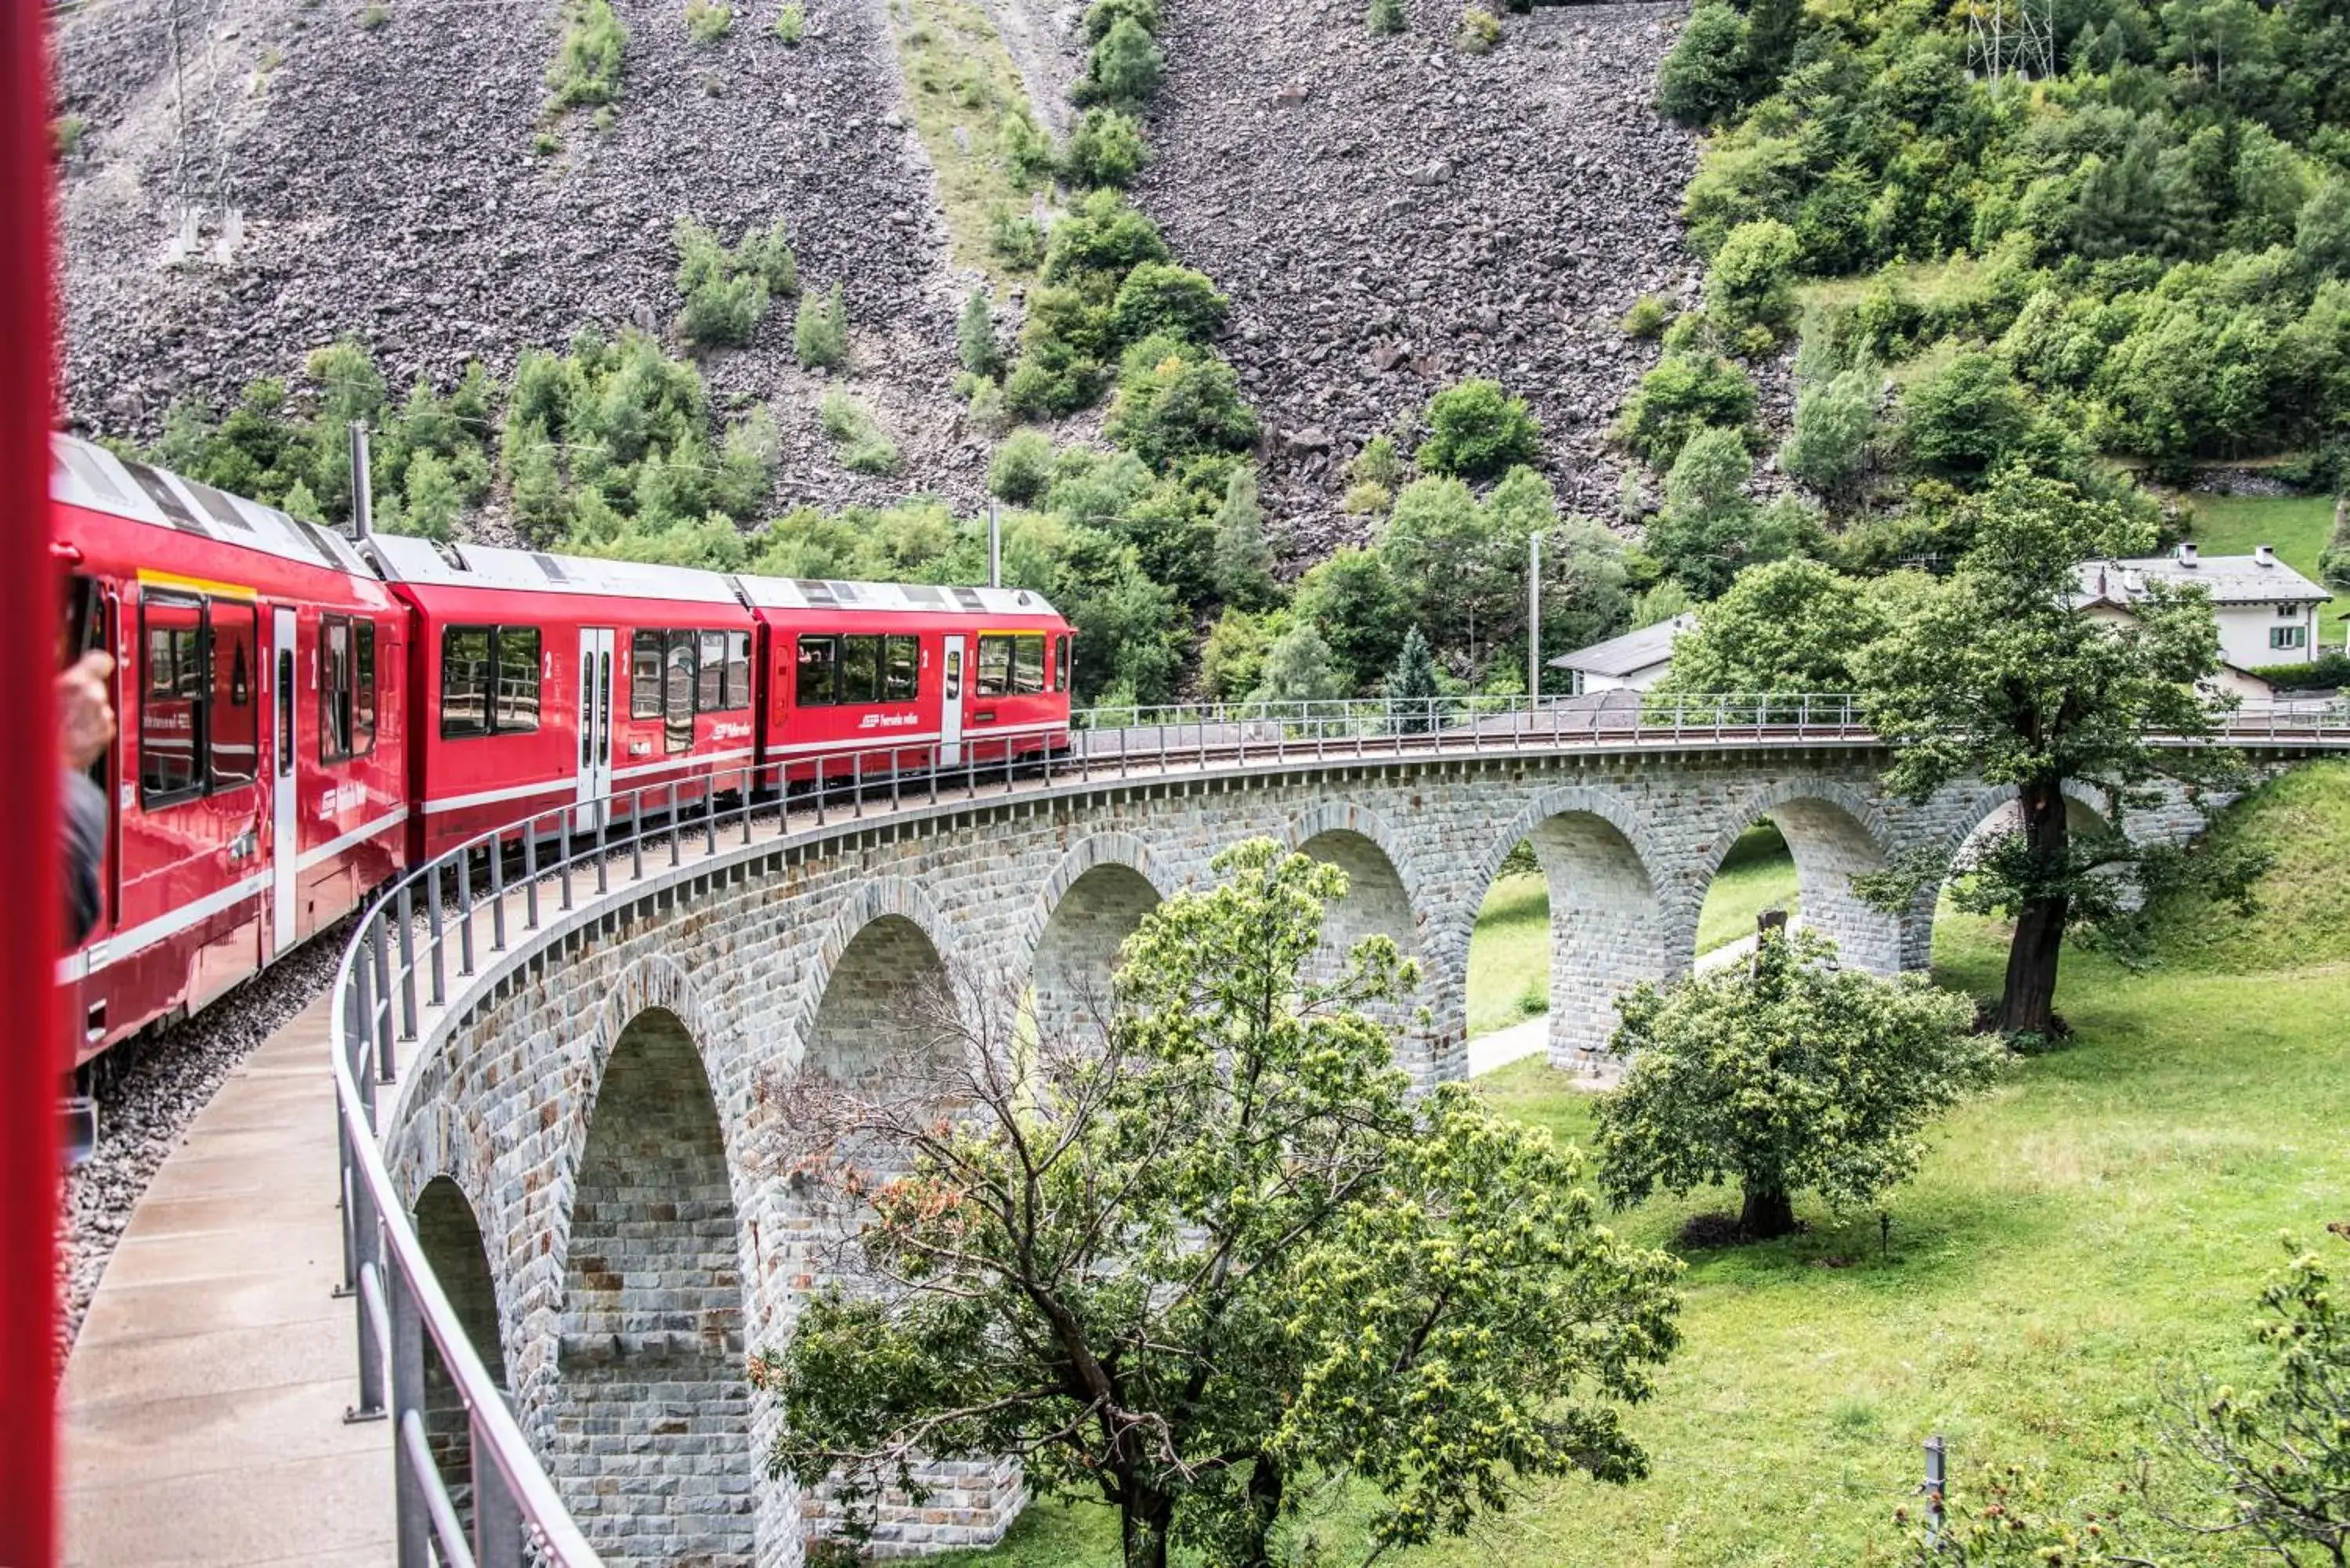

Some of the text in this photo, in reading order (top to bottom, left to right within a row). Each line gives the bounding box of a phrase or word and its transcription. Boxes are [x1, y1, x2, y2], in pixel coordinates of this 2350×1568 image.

[544, 651, 552, 680] 2
[922, 649, 928, 668] 2
[969, 649, 974, 668] 1
